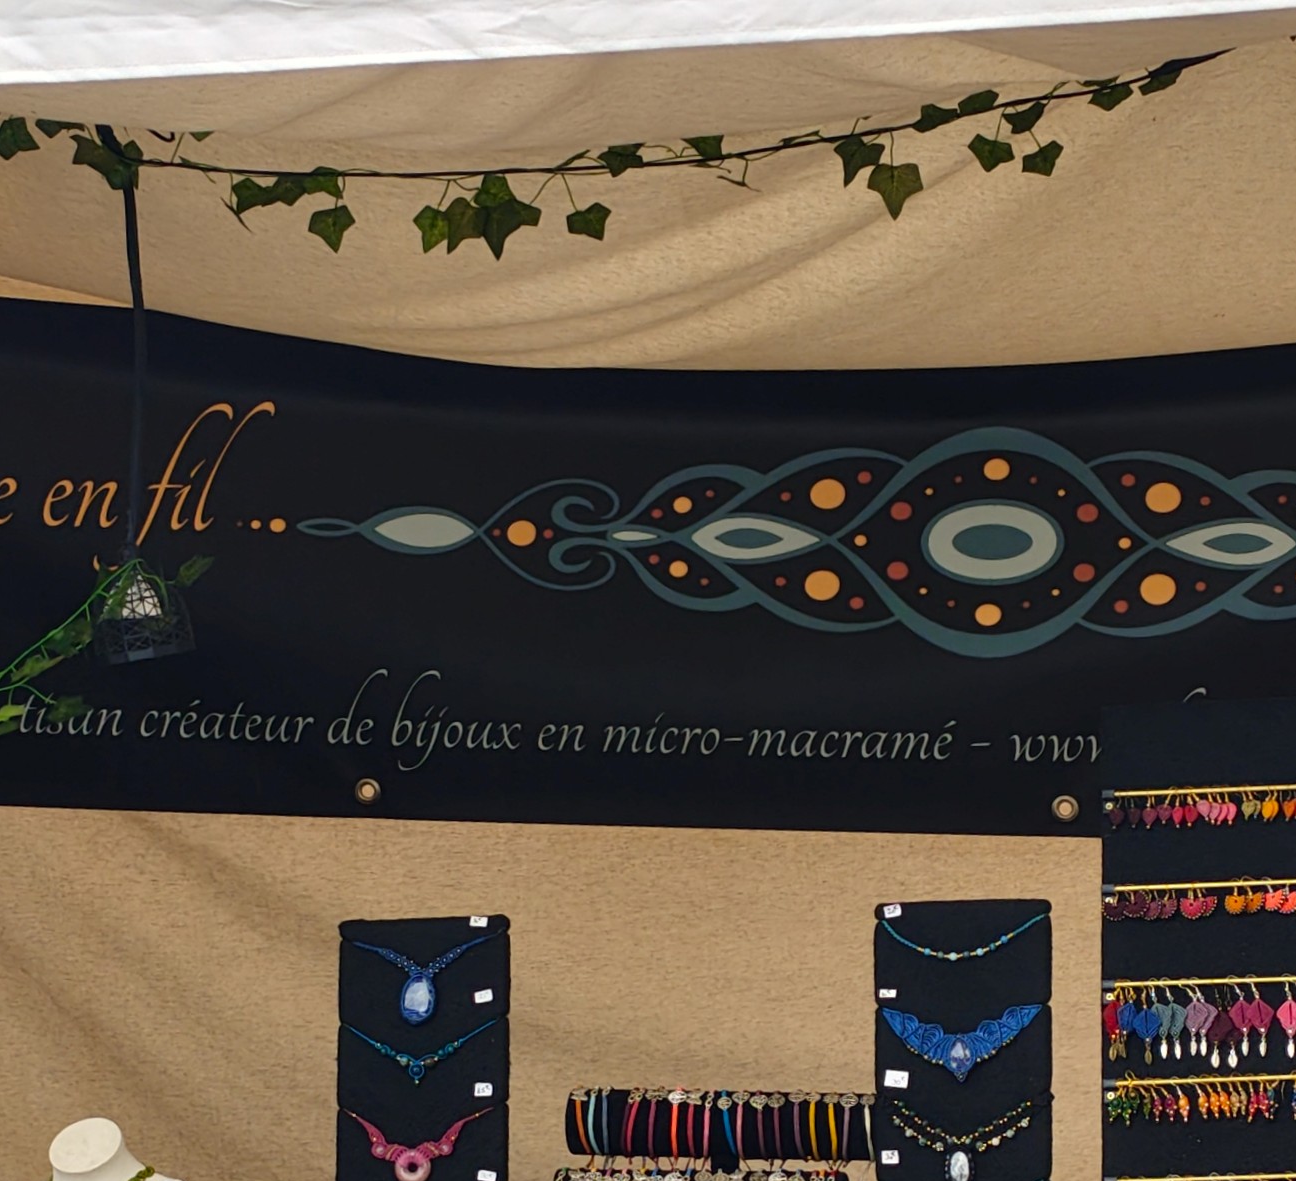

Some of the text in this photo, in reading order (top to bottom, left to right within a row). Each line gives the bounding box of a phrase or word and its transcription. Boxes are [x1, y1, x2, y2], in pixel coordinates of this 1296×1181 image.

[42, 477, 120, 529] en
[92, 401, 277, 571] fil
[139, 699, 314, 743] créateur
[327, 668, 388, 745] de
[390, 669, 522, 771] bijoux
[537, 720, 586, 752] en
[602, 712, 958, 763] micro-macramé
